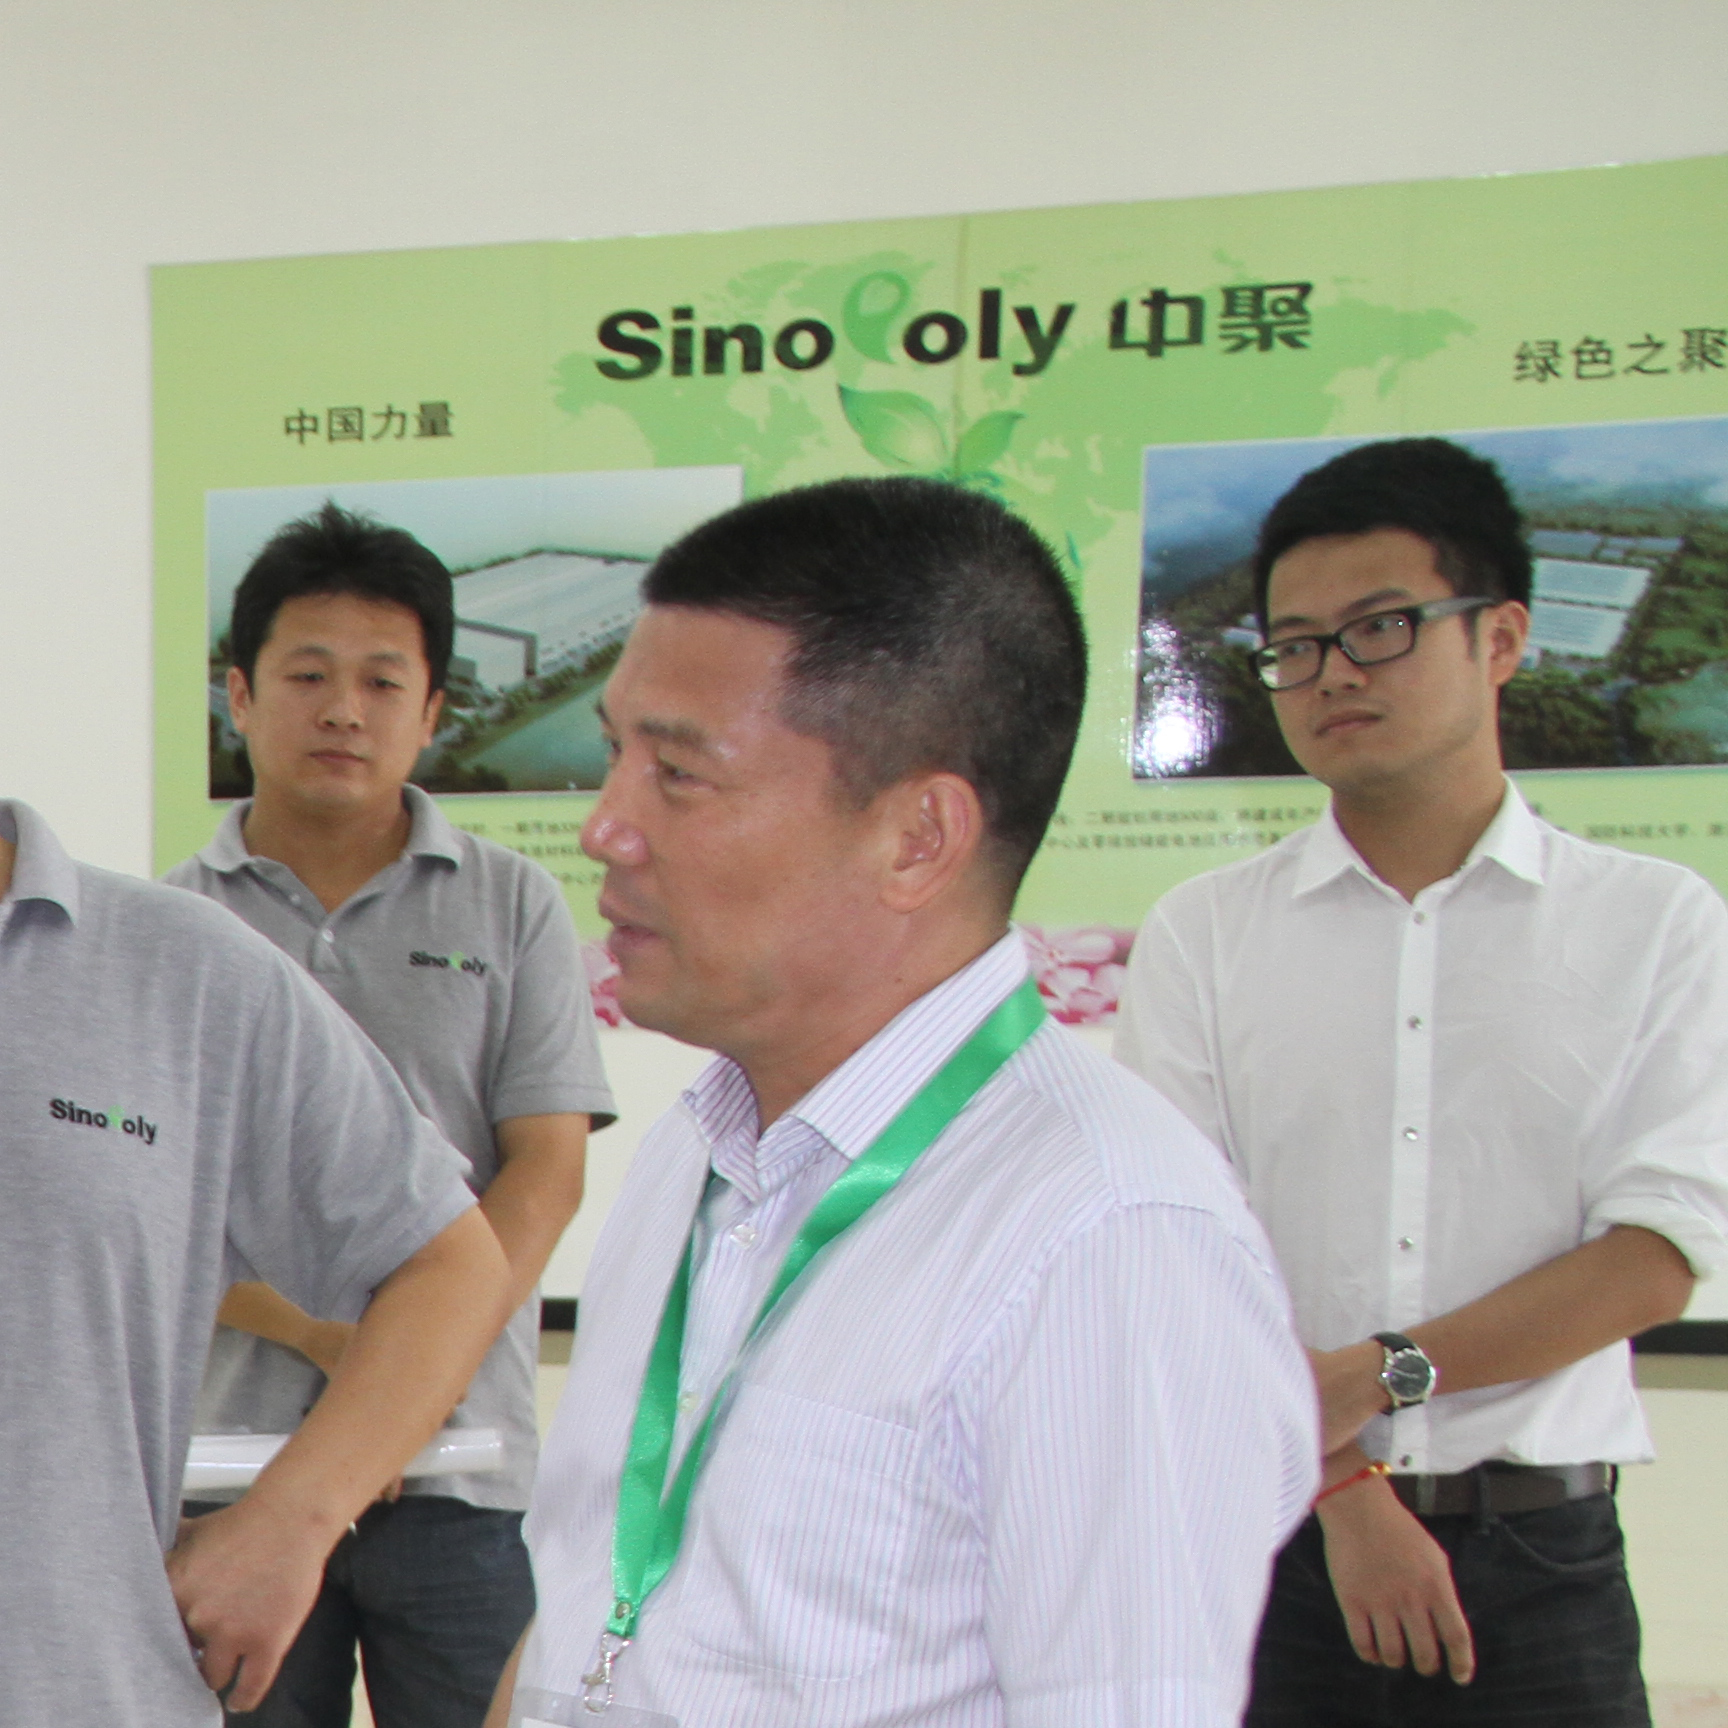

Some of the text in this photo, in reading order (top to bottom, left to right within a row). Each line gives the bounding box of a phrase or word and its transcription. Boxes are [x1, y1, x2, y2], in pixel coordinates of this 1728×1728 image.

[1109, 281, 1315, 357] 中聚
[284, 400, 454, 445] 中国力量
